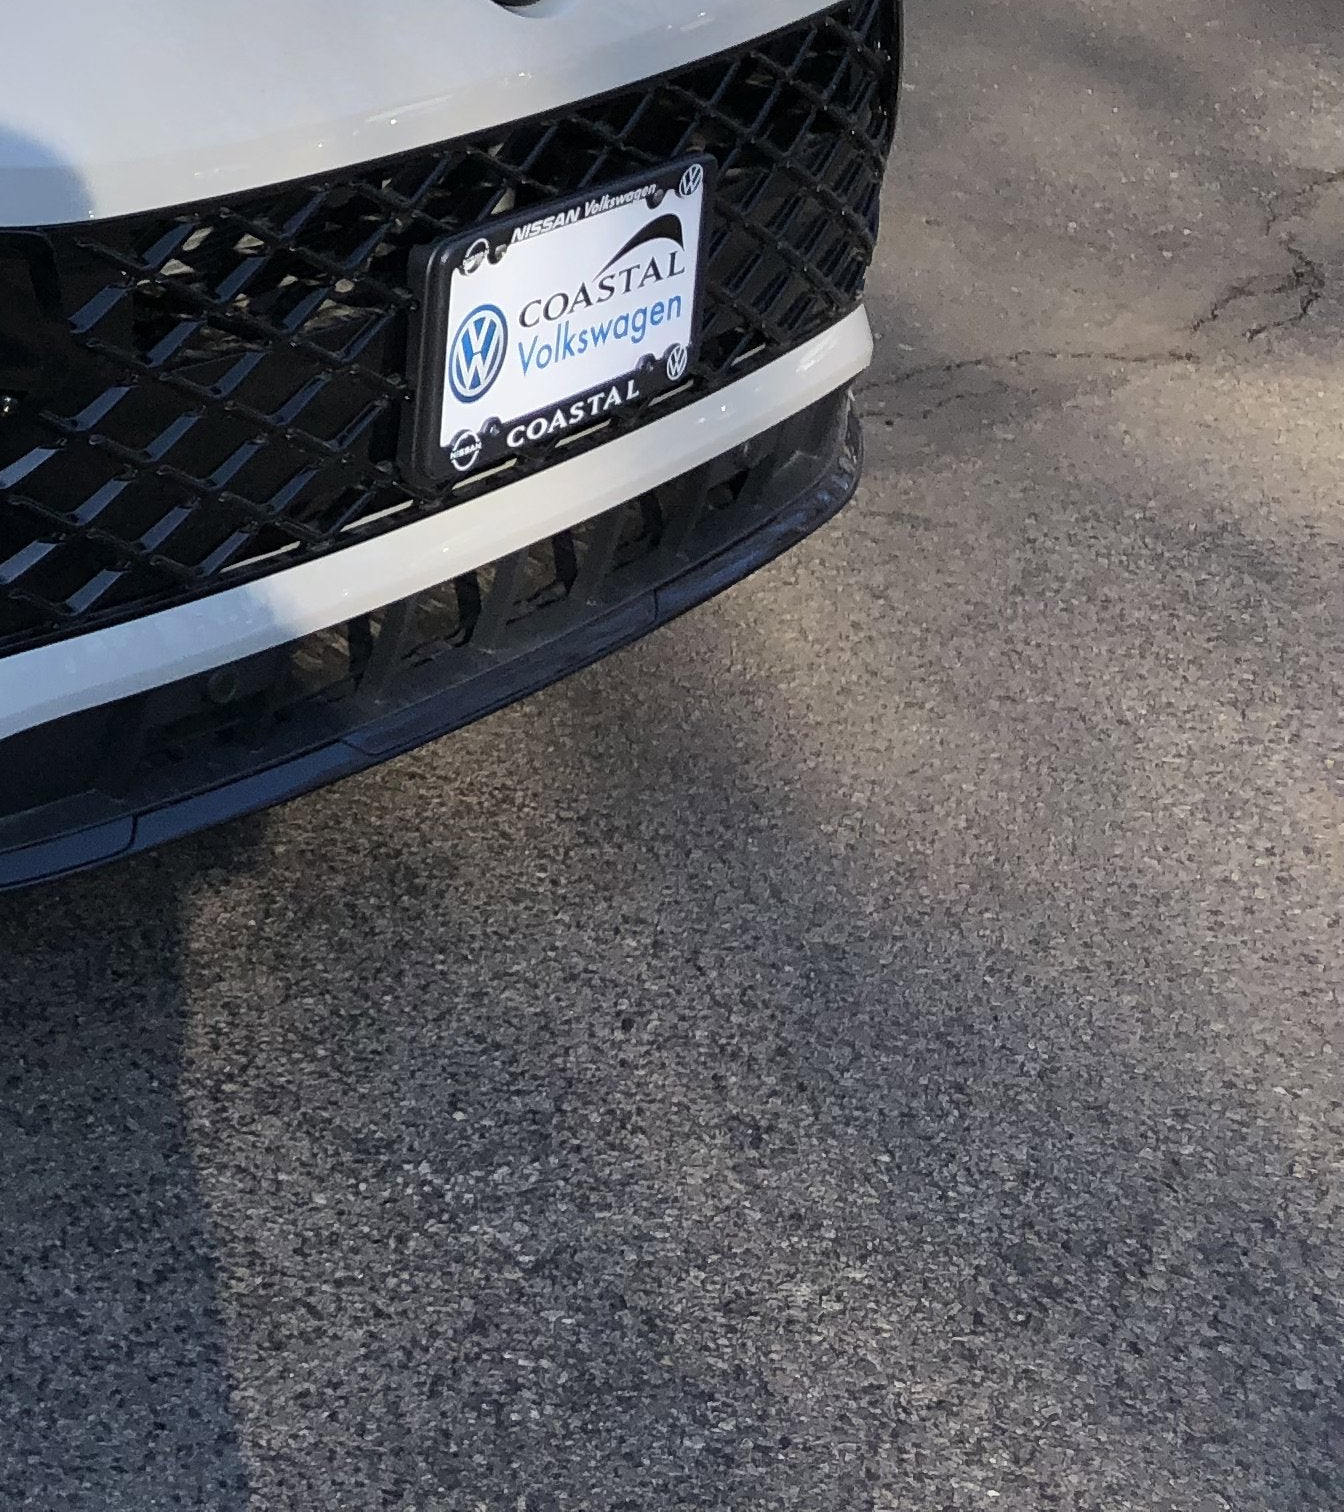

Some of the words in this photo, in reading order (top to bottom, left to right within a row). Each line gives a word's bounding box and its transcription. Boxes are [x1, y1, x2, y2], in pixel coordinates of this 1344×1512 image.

[511, 206, 582, 244] NISSAN
[584, 183, 657, 218] Volkswagen
[518, 250, 686, 328] COASTAL
[518, 294, 682, 377] Volkswagen
[506, 379, 640, 448] COASTAL
